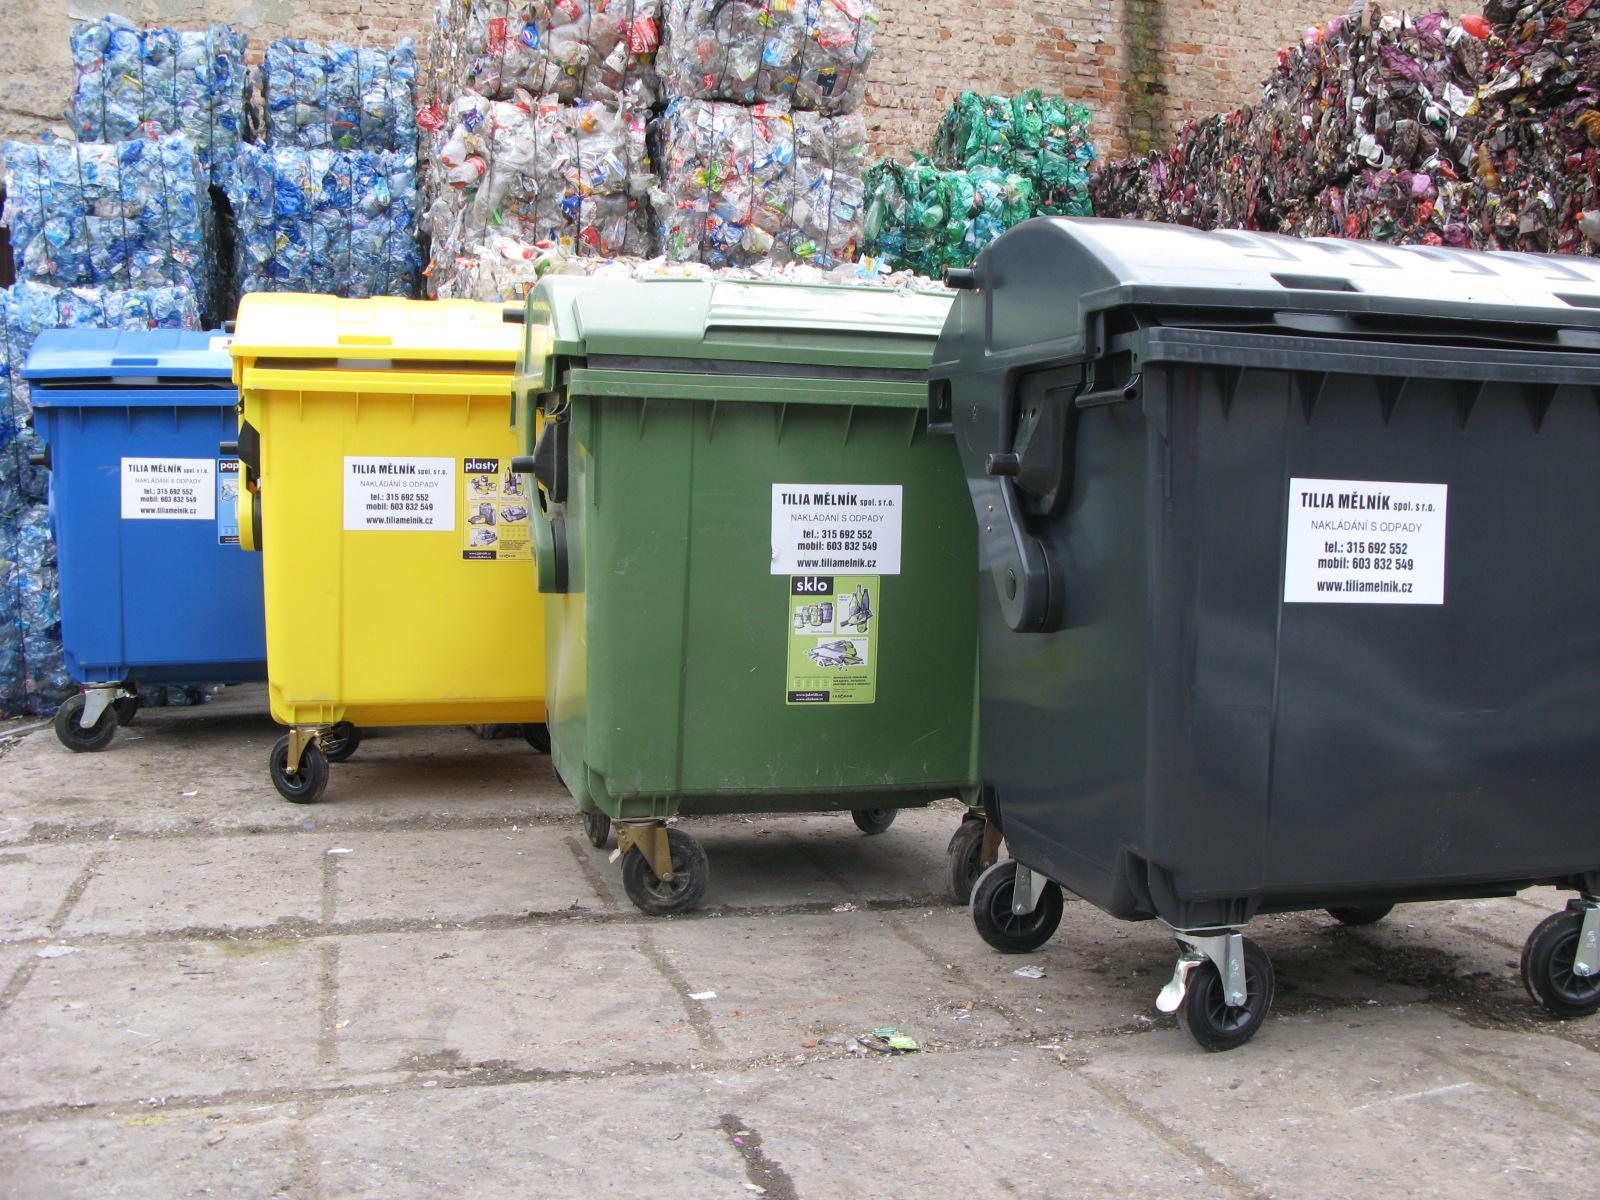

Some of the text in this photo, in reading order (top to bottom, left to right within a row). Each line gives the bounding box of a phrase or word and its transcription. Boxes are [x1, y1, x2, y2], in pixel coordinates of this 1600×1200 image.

[128, 464, 149, 473] TILIA
[352, 464, 376, 474] TILIA
[379, 463, 416, 474] MĚLNÍK
[465, 458, 498, 472] plasty
[359, 479, 401, 487] NAKLÁDÁNÍ
[370, 493, 384, 501] tel.:
[386, 493, 399, 501] 315
[781, 493, 810, 505] TILIA
[813, 492, 857, 506] MĚLNÍK
[859, 498, 877, 507] spol.
[1301, 492, 1334, 509] TILIA
[1338, 491, 1390, 510] MĚLNÍK
[1393, 501, 1413, 512] spol.
[1421, 503, 1436, 512] r.o.
[405, 503, 418, 511] 832
[420, 503, 434, 511] 549
[366, 516, 433, 525] www.tiliamelnik.cz
[790, 513, 884, 522] NAKLÁDÁNÍ S ODPADY
[1311, 518, 1422, 533] NAKLÁDÁNÍ S ODPADY
[803, 530, 872, 539] tel.: 315 692 552
[797, 541, 878, 551] mobil: 603 832 549
[1324, 541, 1408, 555] tel.: 315 692 552
[797, 559, 876, 568] www.tiliamelnik.cz
[1318, 557, 1414, 570] mobil: 603 832 549
[796, 576, 828, 591] sklo
[1317, 580, 1413, 593] www.tiliamelnik.cz
